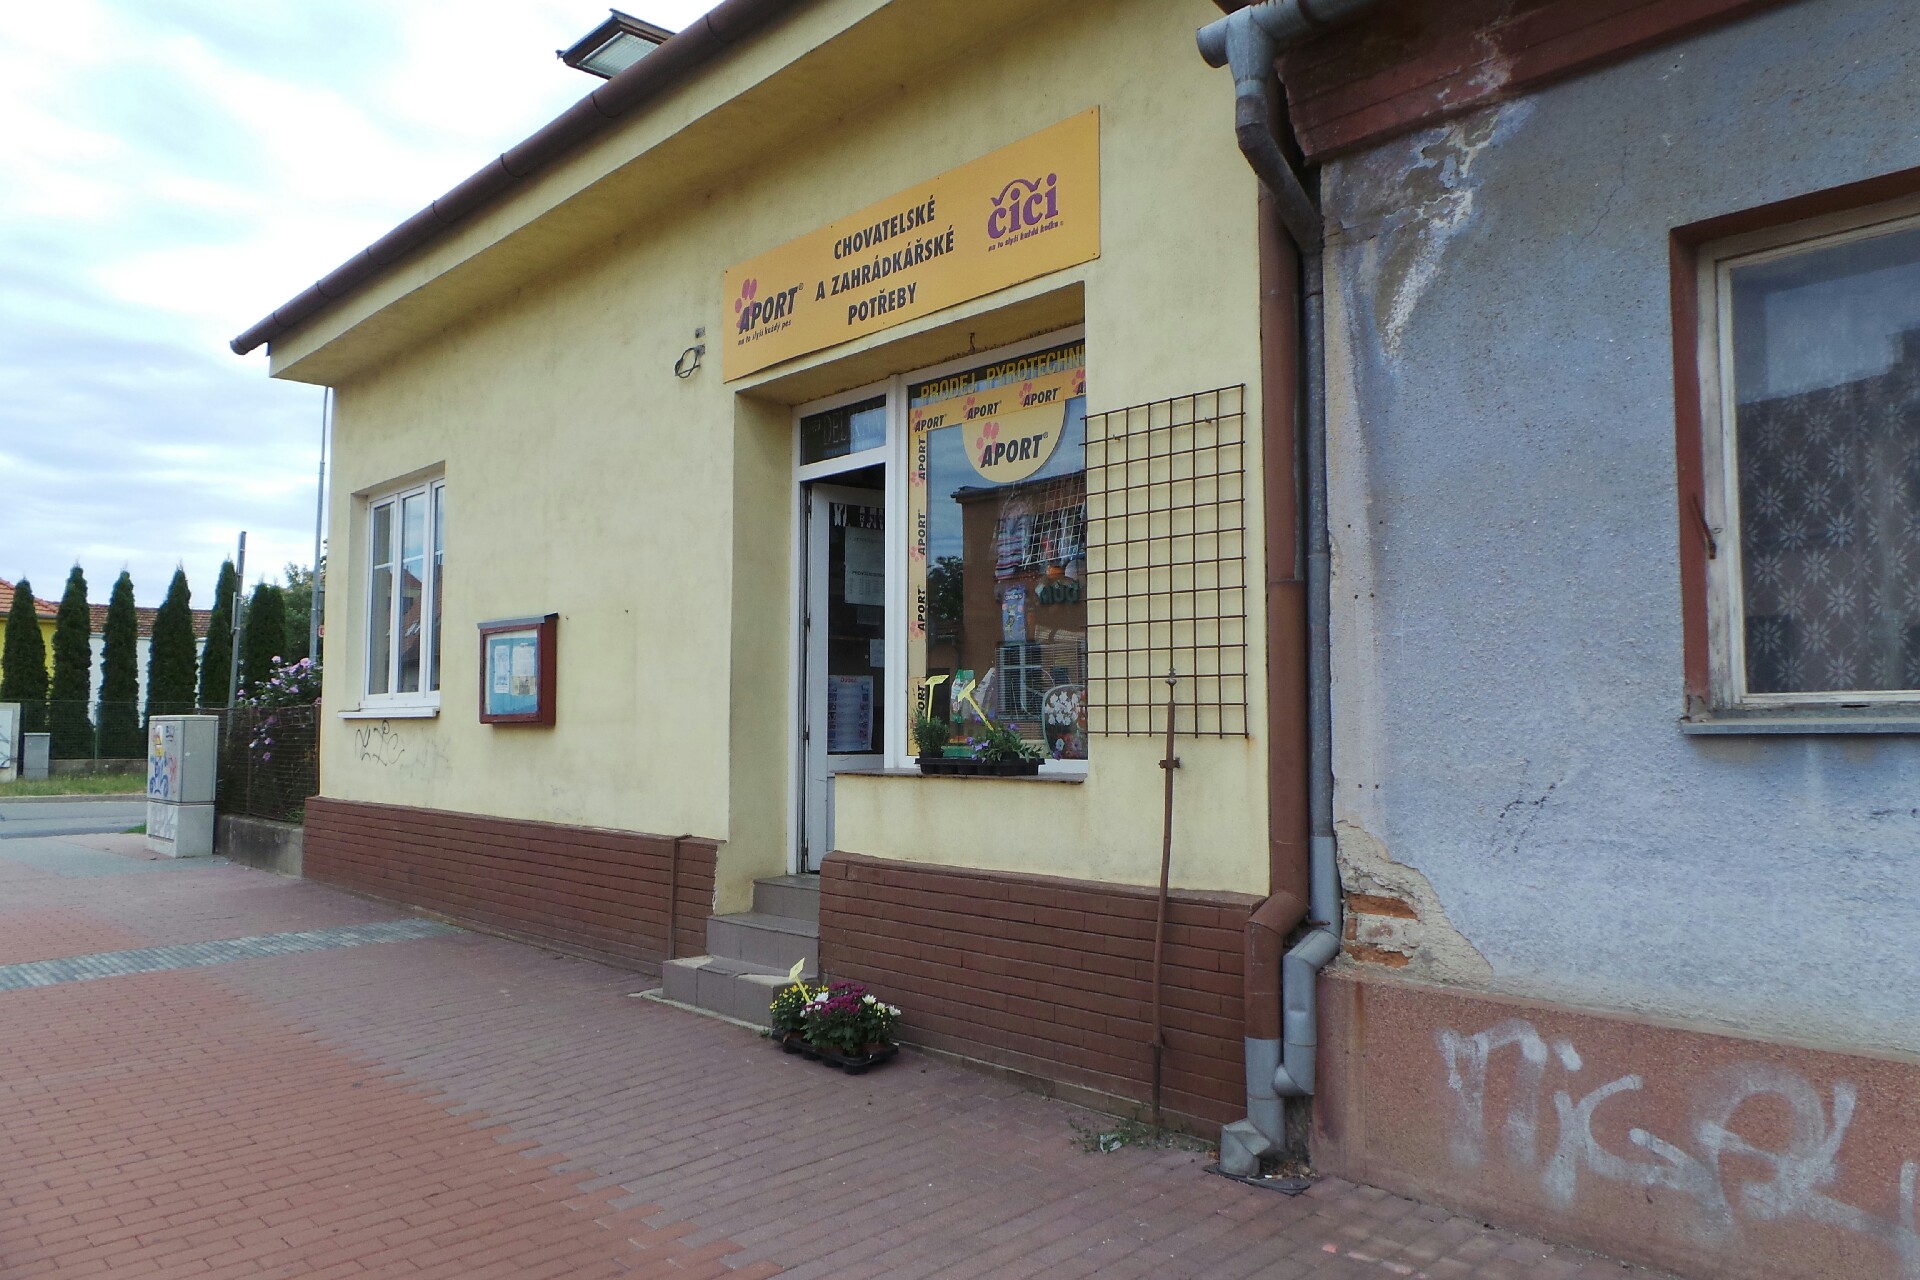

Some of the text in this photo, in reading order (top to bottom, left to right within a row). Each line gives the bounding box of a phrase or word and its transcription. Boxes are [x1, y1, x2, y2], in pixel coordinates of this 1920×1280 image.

[834, 194, 936, 260] CHOVATELSKÉ
[815, 224, 955, 302] A ZAHRÁDKÁŘSKÉ
[738, 285, 799, 335] APORT
[847, 281, 917, 326] POTŘEBY
[920, 372, 977, 402] PRODEJ
[1022, 387, 1059, 408] APORT
[914, 414, 945, 433] APORT
[966, 401, 1000, 421] APORT
[918, 438, 926, 481] APORT
[980, 433, 1043, 469] APORT
[917, 514, 926, 556] APORT
[917, 588, 926, 632] APORT
